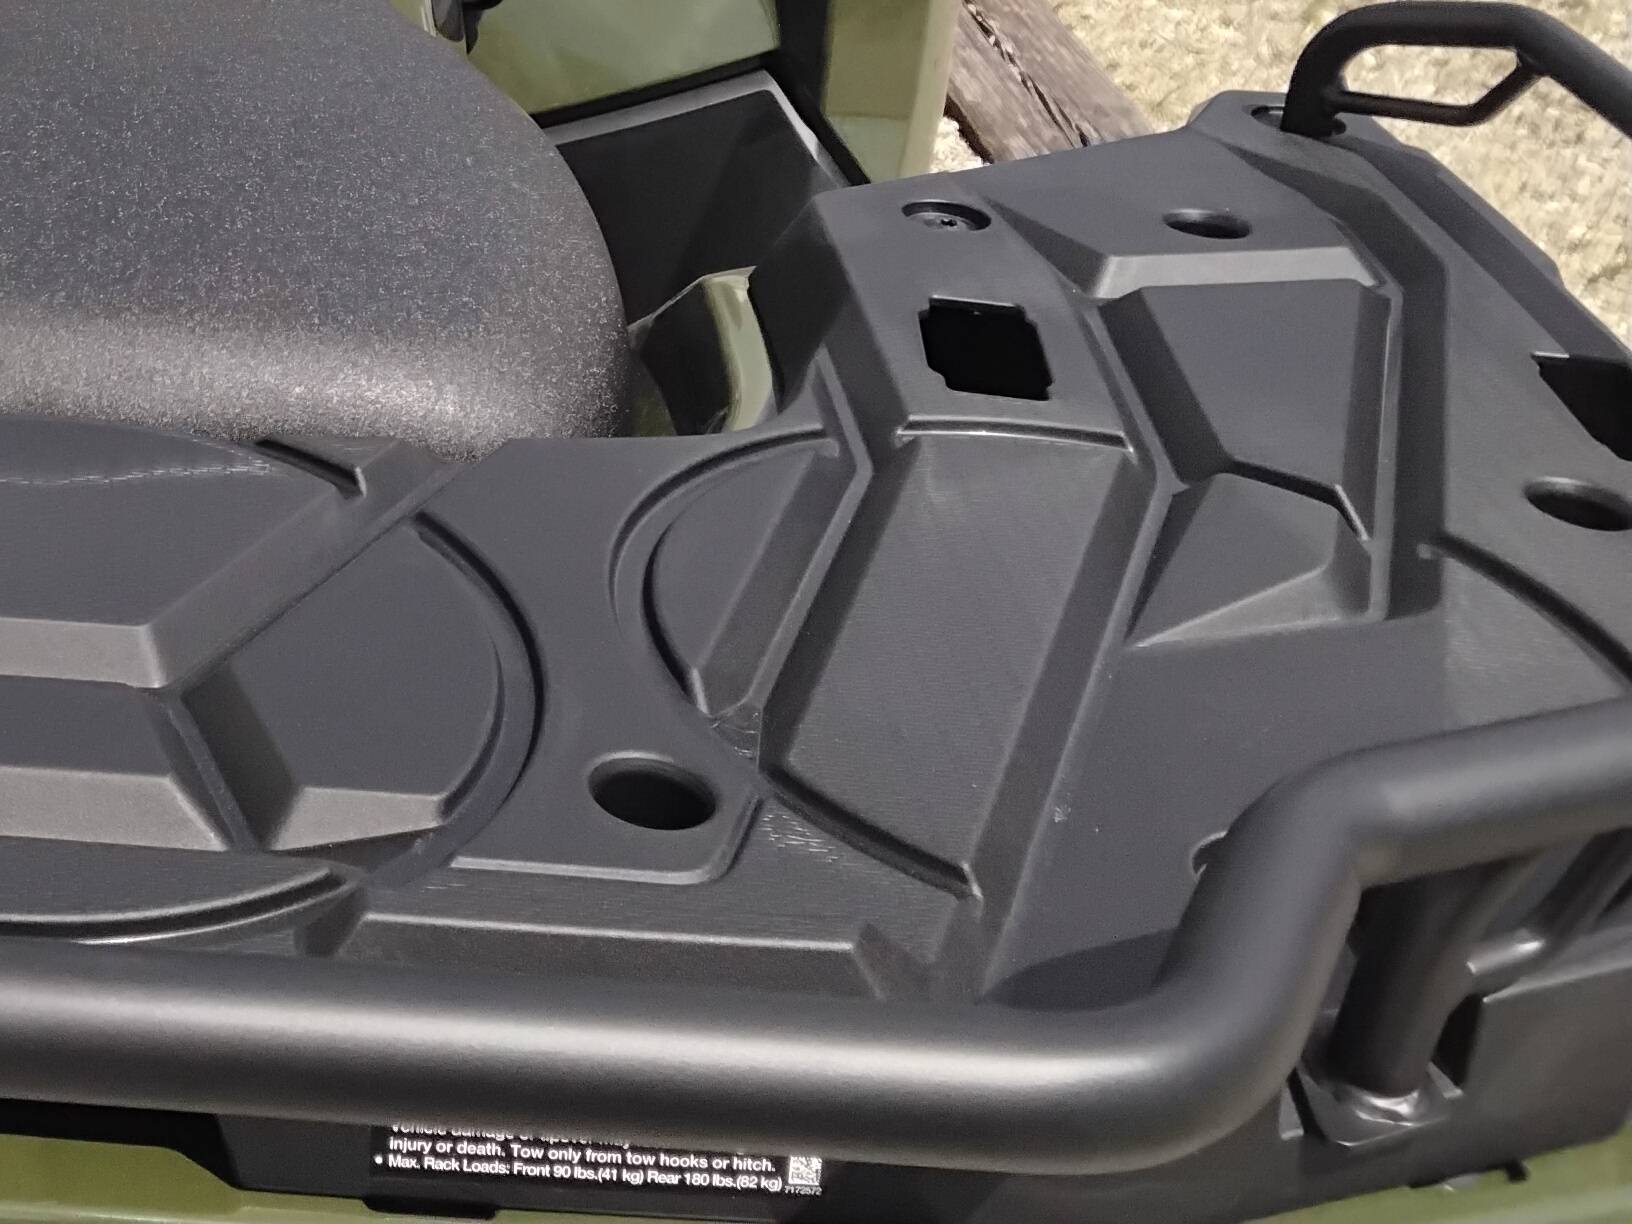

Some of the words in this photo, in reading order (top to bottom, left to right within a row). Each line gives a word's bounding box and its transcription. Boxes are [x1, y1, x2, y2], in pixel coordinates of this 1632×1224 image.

[389, 1154, 421, 1169] Max.
[424, 1156, 460, 1172] Rack
[463, 1158, 509, 1174] Loads:
[513, 1163, 550, 1177] Front
[553, 1166, 571, 1178] 90
[623, 1169, 644, 1185] kg)
[647, 1170, 682, 1184] Rear
[684, 1173, 709, 1186] 180
[761, 1175, 782, 1191] kg)
[436, 1141, 453, 1153] or
[456, 1141, 506, 1157] death.
[511, 1144, 544, 1160] Tow
[548, 1148, 581, 1163] only
[586, 1149, 622, 1165] from
[627, 1152, 655, 1167] tow
[660, 1154, 708, 1169] hooks
[712, 1158, 730, 1169] or
[733, 1156, 776, 1172] hitch.
